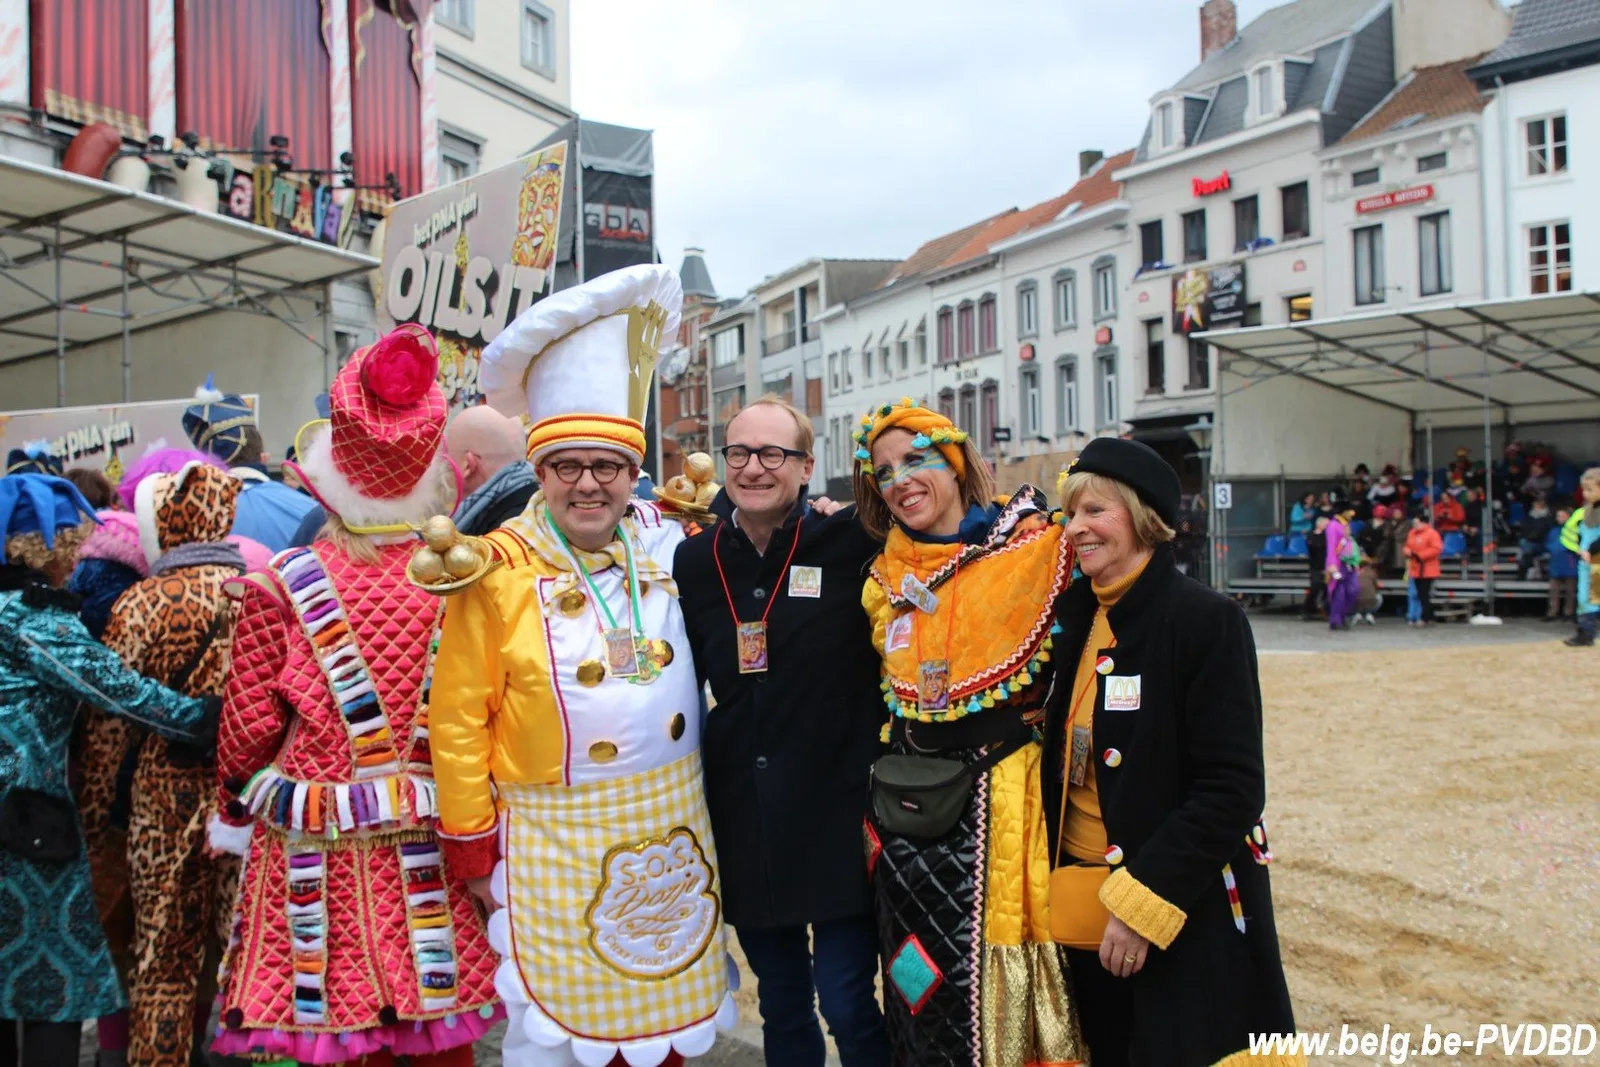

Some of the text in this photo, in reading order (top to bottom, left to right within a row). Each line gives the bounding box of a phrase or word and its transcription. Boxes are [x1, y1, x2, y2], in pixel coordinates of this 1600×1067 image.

[414, 192, 478, 250] het DNA van
[387, 245, 546, 343] OILSJT
[67, 425, 101, 463] DNA
[101, 420, 132, 459] van
[1218, 487, 1229, 506] 3
